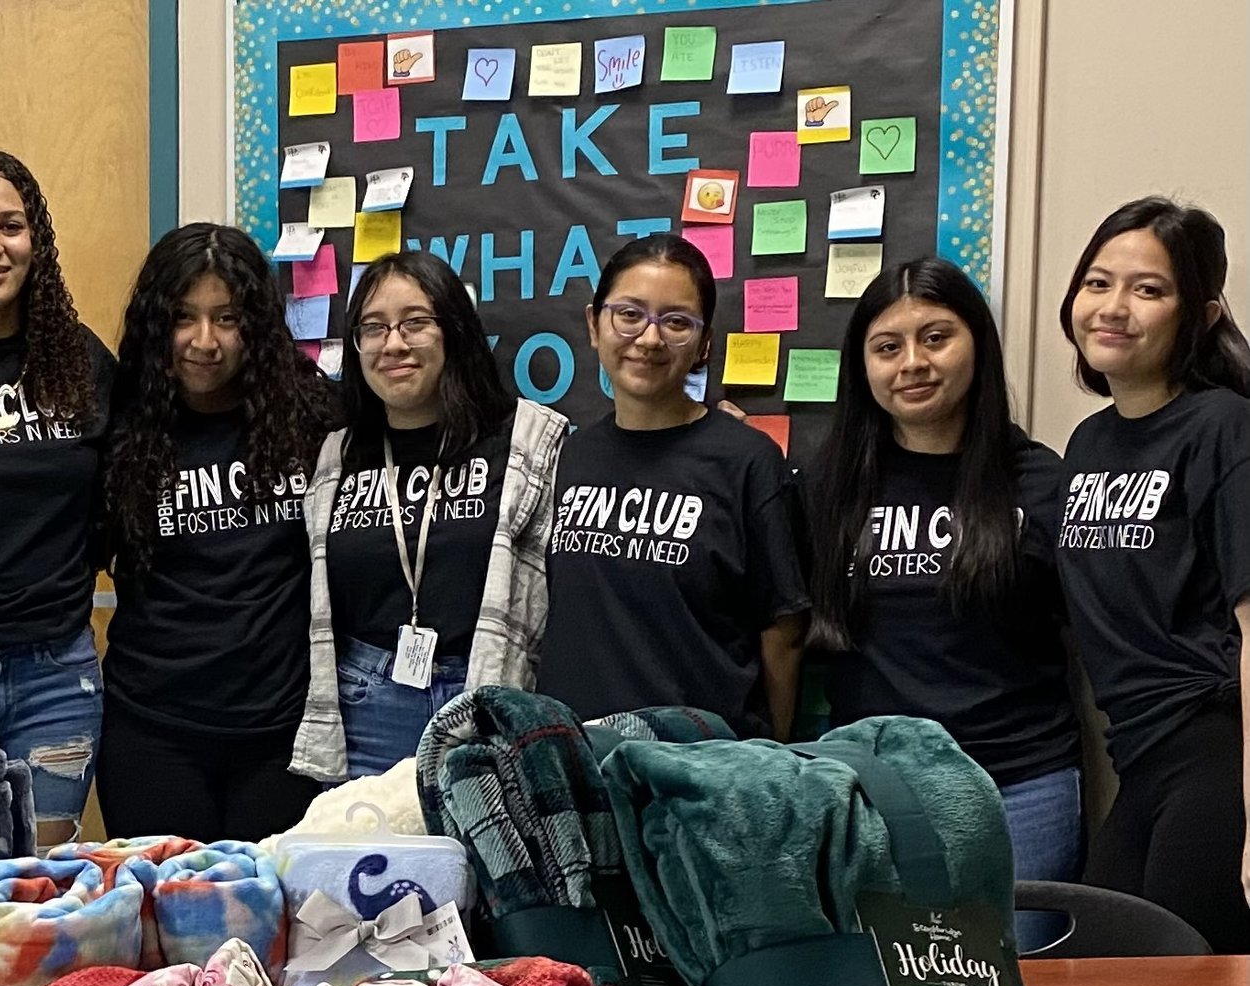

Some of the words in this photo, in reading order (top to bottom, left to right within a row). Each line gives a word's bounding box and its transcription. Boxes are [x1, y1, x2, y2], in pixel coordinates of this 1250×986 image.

[671, 34, 696, 45] YOU
[597, 48, 641, 82] Smile
[415, 101, 701, 186] TAKE
[25, 422, 43, 442] IN
[175, 463, 223, 510] FIN
[1069, 472, 1110, 521] FIN
[1105, 469, 1170, 521] CLUB
[177, 506, 249, 535] FOSTERS
[254, 503, 270, 525] IN
[444, 497, 486, 520] NEED
[563, 485, 614, 529] FIN
[618, 487, 703, 540] CLUB
[558, 530, 624, 557] FOSTERS
[626, 537, 644, 560] IN
[645, 538, 690, 566] NEED
[1116, 523, 1155, 550] NEED
[869, 552, 942, 577] OSTERS
